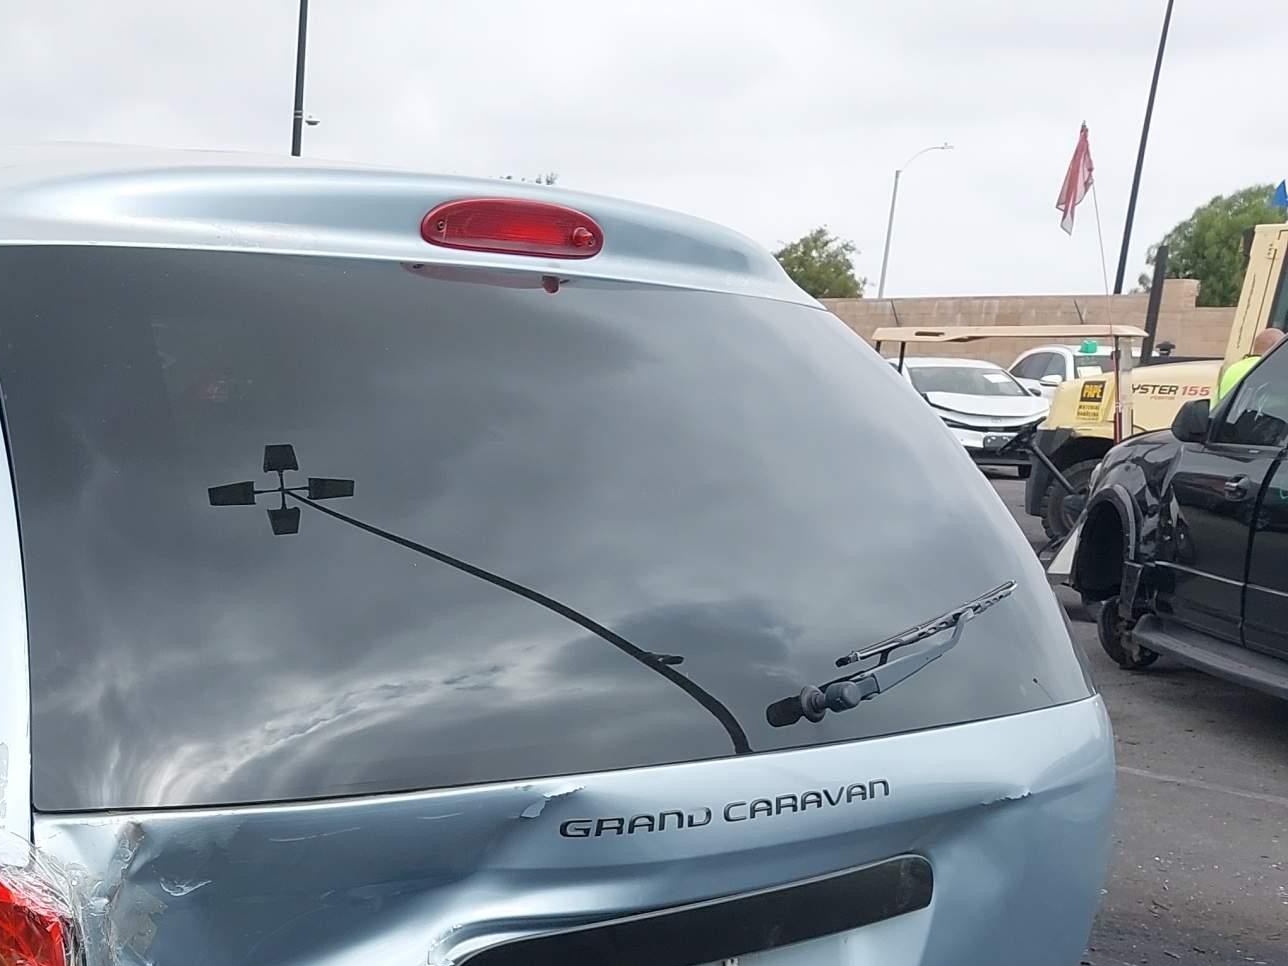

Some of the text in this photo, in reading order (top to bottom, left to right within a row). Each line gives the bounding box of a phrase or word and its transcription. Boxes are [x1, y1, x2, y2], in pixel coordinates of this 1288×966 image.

[1132, 384, 1210, 396] YSTER 155
[559, 778, 890, 838] GRAND CARAVAN
